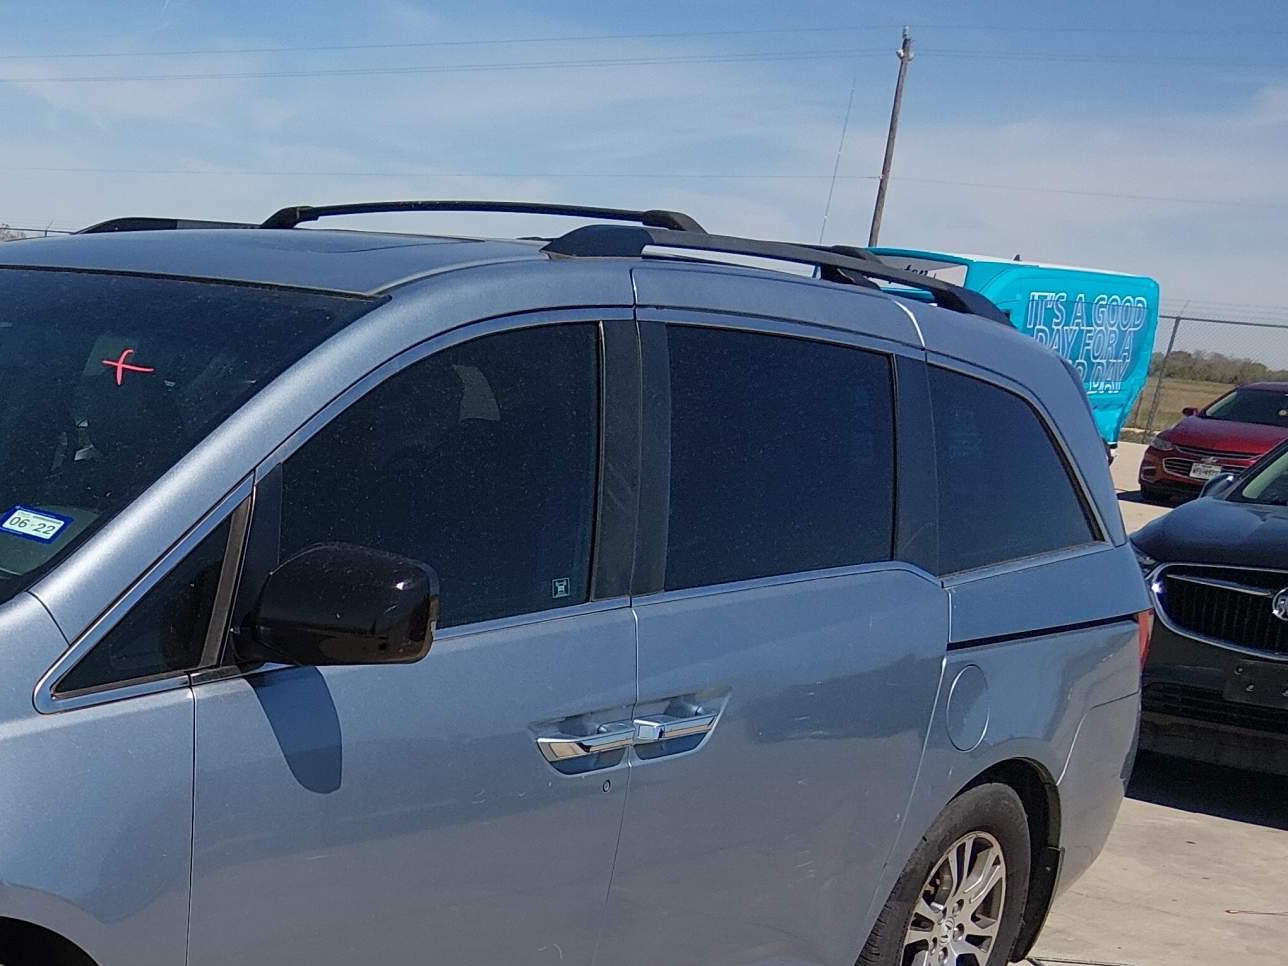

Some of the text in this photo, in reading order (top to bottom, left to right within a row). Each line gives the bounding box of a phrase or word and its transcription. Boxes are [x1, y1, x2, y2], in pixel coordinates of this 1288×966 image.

[1026, 292, 1148, 330] IT'S A GOOD
[1079, 326, 1119, 362] FOR
[1118, 328, 1134, 362] A
[9, 516, 56, 535] 06-22
